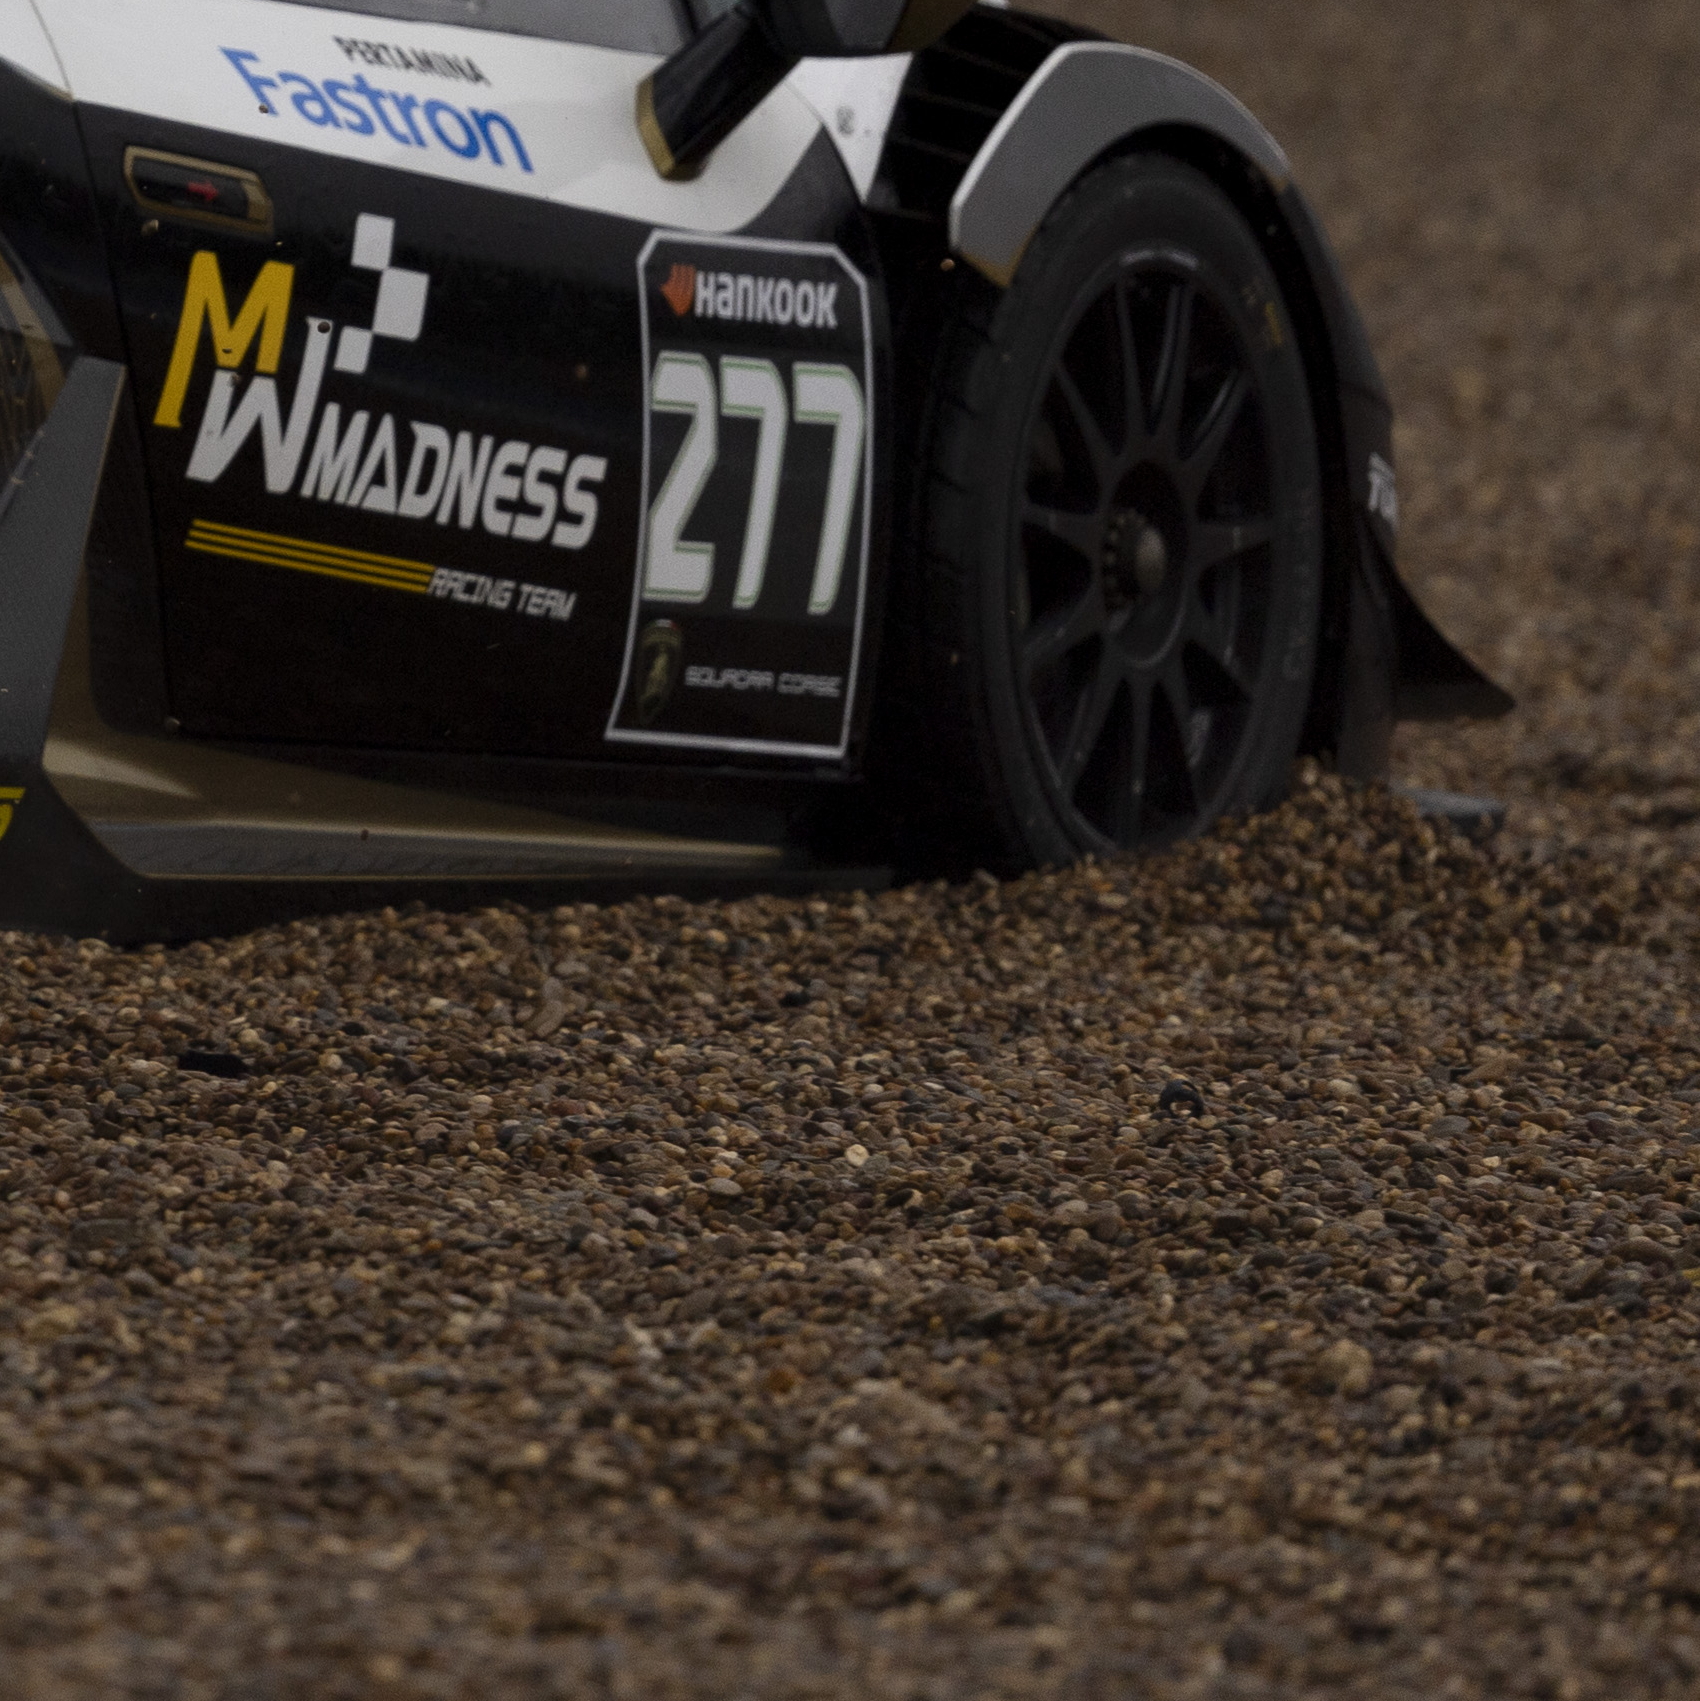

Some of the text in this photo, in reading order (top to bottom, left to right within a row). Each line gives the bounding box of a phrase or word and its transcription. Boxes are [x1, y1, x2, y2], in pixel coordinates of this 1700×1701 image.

[218, 46, 534, 173] Fastron
[333, 36, 491, 86] PERTAMINA
[299, 401, 609, 551] MADNESS
[642, 349, 865, 615] 277
[428, 566, 578, 622] RACING TEAM
